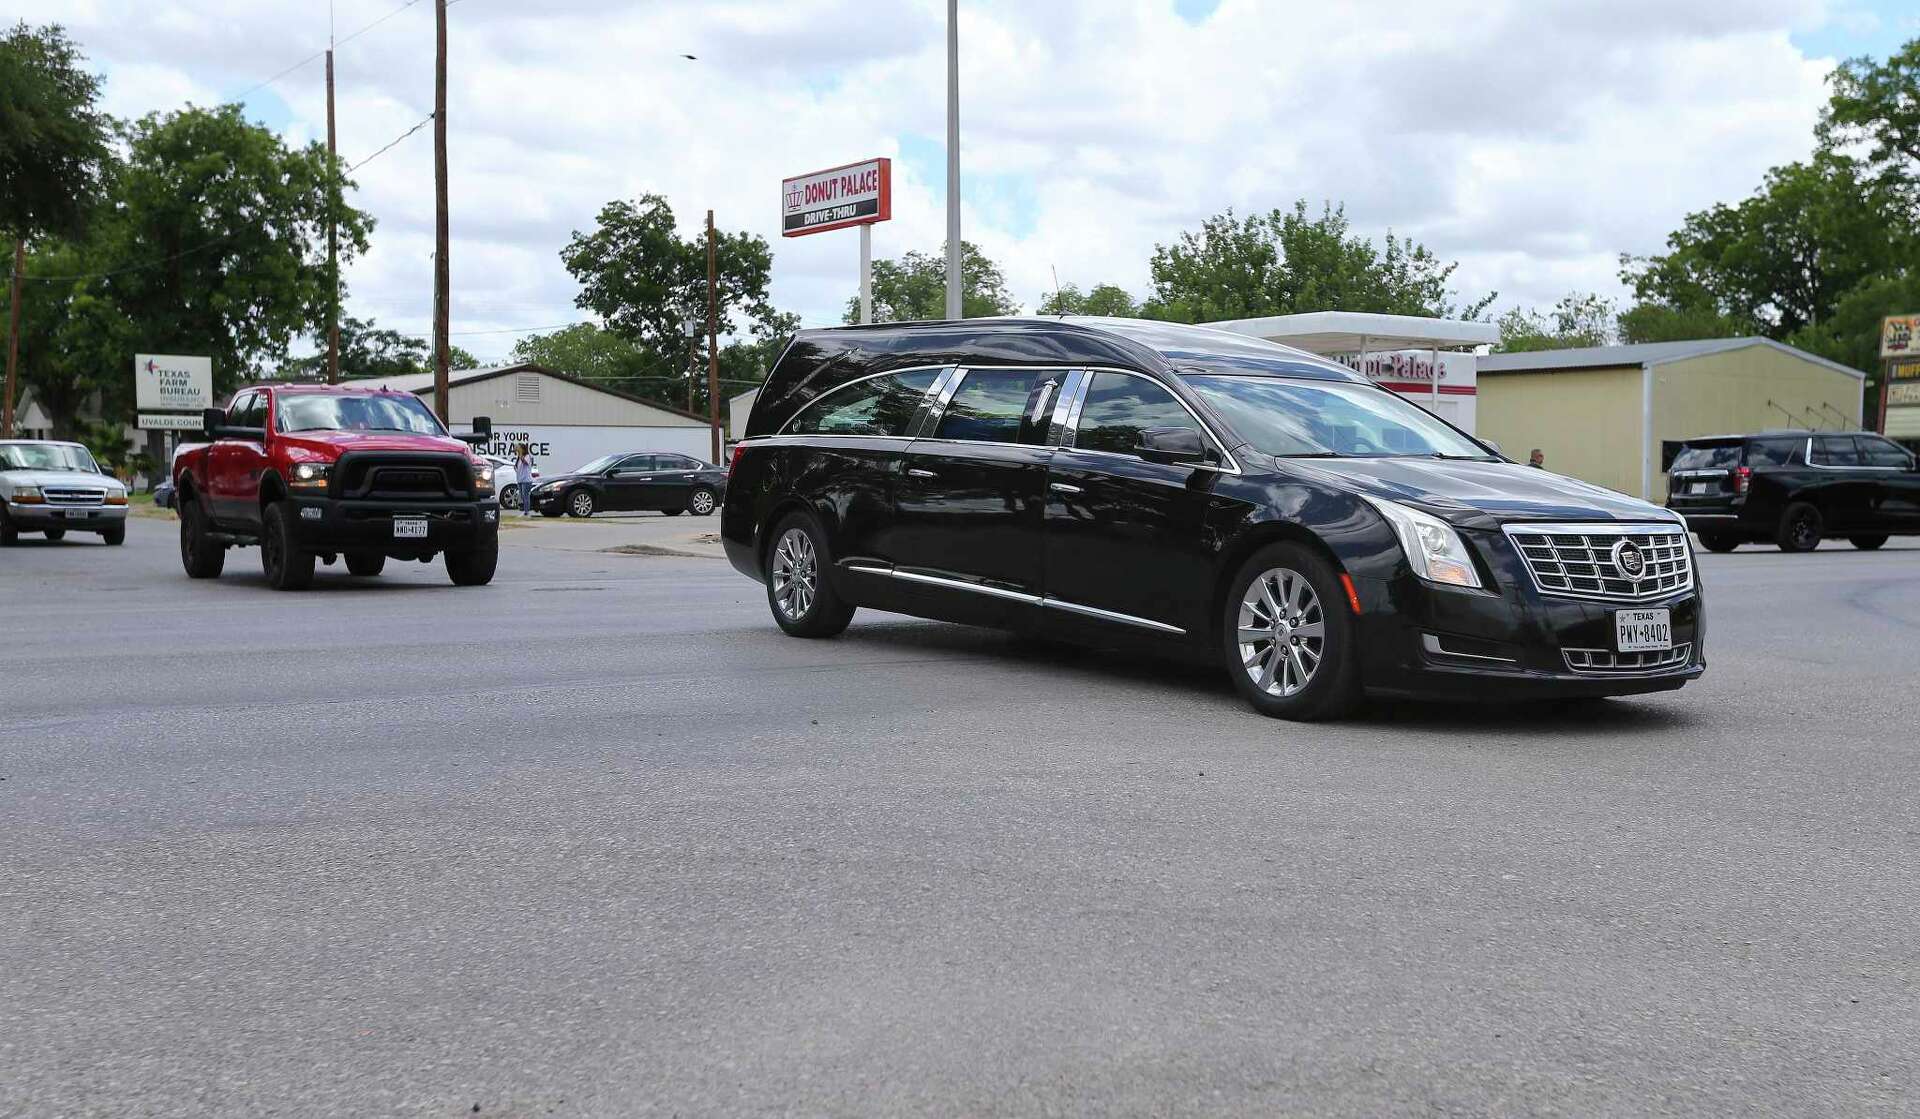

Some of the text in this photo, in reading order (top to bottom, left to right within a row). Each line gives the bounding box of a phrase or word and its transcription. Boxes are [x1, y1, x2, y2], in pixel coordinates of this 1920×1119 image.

[805, 169, 878, 205] DONUT PALACE
[803, 204, 857, 225] DRIVE-THRU
[158, 370, 191, 378] TEXAS
[159, 379, 188, 387] FARM
[160, 388, 201, 396] BUREAU
[503, 432, 530, 441] YOUR
[1633, 612, 1654, 621] TEXAS
